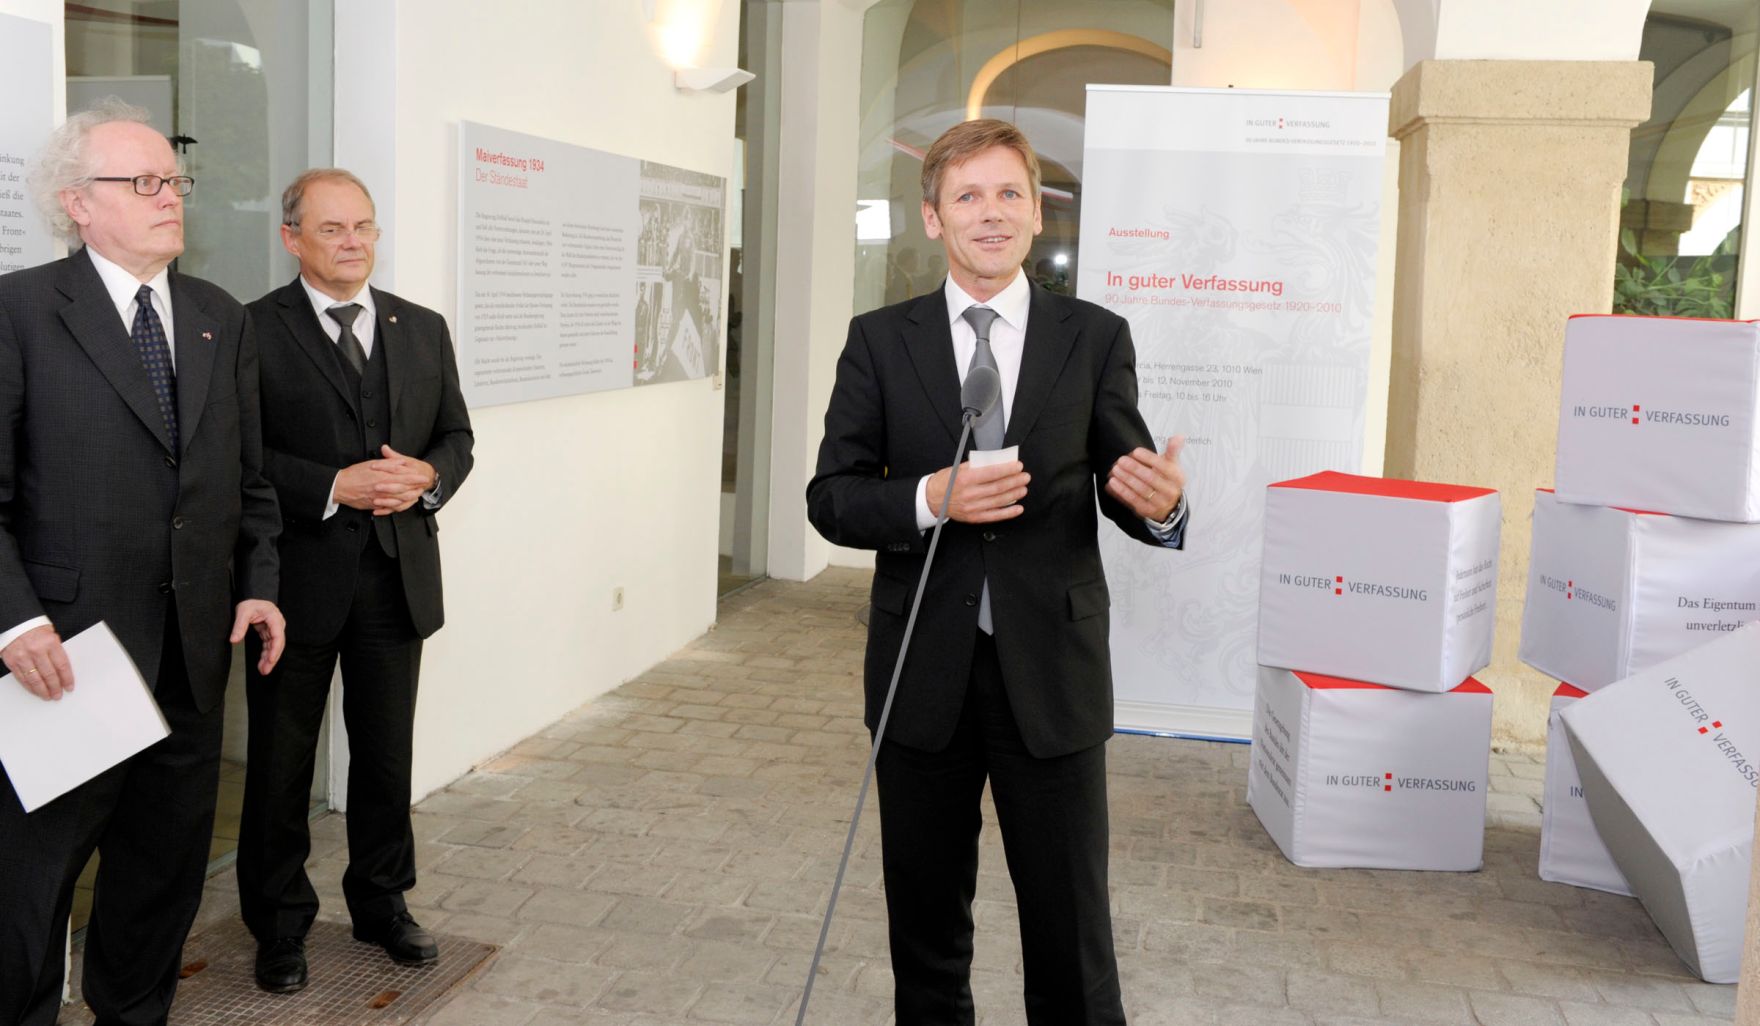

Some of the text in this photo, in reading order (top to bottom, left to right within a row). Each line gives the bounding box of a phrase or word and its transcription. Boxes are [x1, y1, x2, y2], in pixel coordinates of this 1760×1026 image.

[1286, 120, 1331, 129] VERFASSUNG
[476, 147, 545, 173] Maiverfassung 1934
[475, 167, 489, 183] Der
[1108, 227, 1170, 240] Ausstellung
[1106, 271, 1284, 296] In guter Verfassung
[1105, 294, 1119, 304] 90
[1121, 294, 1149, 304] Jahre
[1153, 362, 1204, 374] Herrengasse
[1222, 364, 1241, 374] 1010
[1242, 365, 1263, 375] Wien
[1169, 376, 1210, 388] November
[1211, 379, 1233, 389] 2010
[1573, 405, 1730, 427] IN GUTER VERFASSUNG
[1279, 573, 1428, 601] IN GUTER VERFASSUNG
[1540, 574, 1617, 612] IN GUTER VERFASSUNG
[1677, 596, 1700, 609] Das
[1703, 597, 1757, 612] Eigentum
[1664, 677, 1759, 788] IN GUTER VERFASSU
[1326, 775, 1476, 792] IN GUTER VERFASSUNG
[1570, 786, 1585, 798] IN
